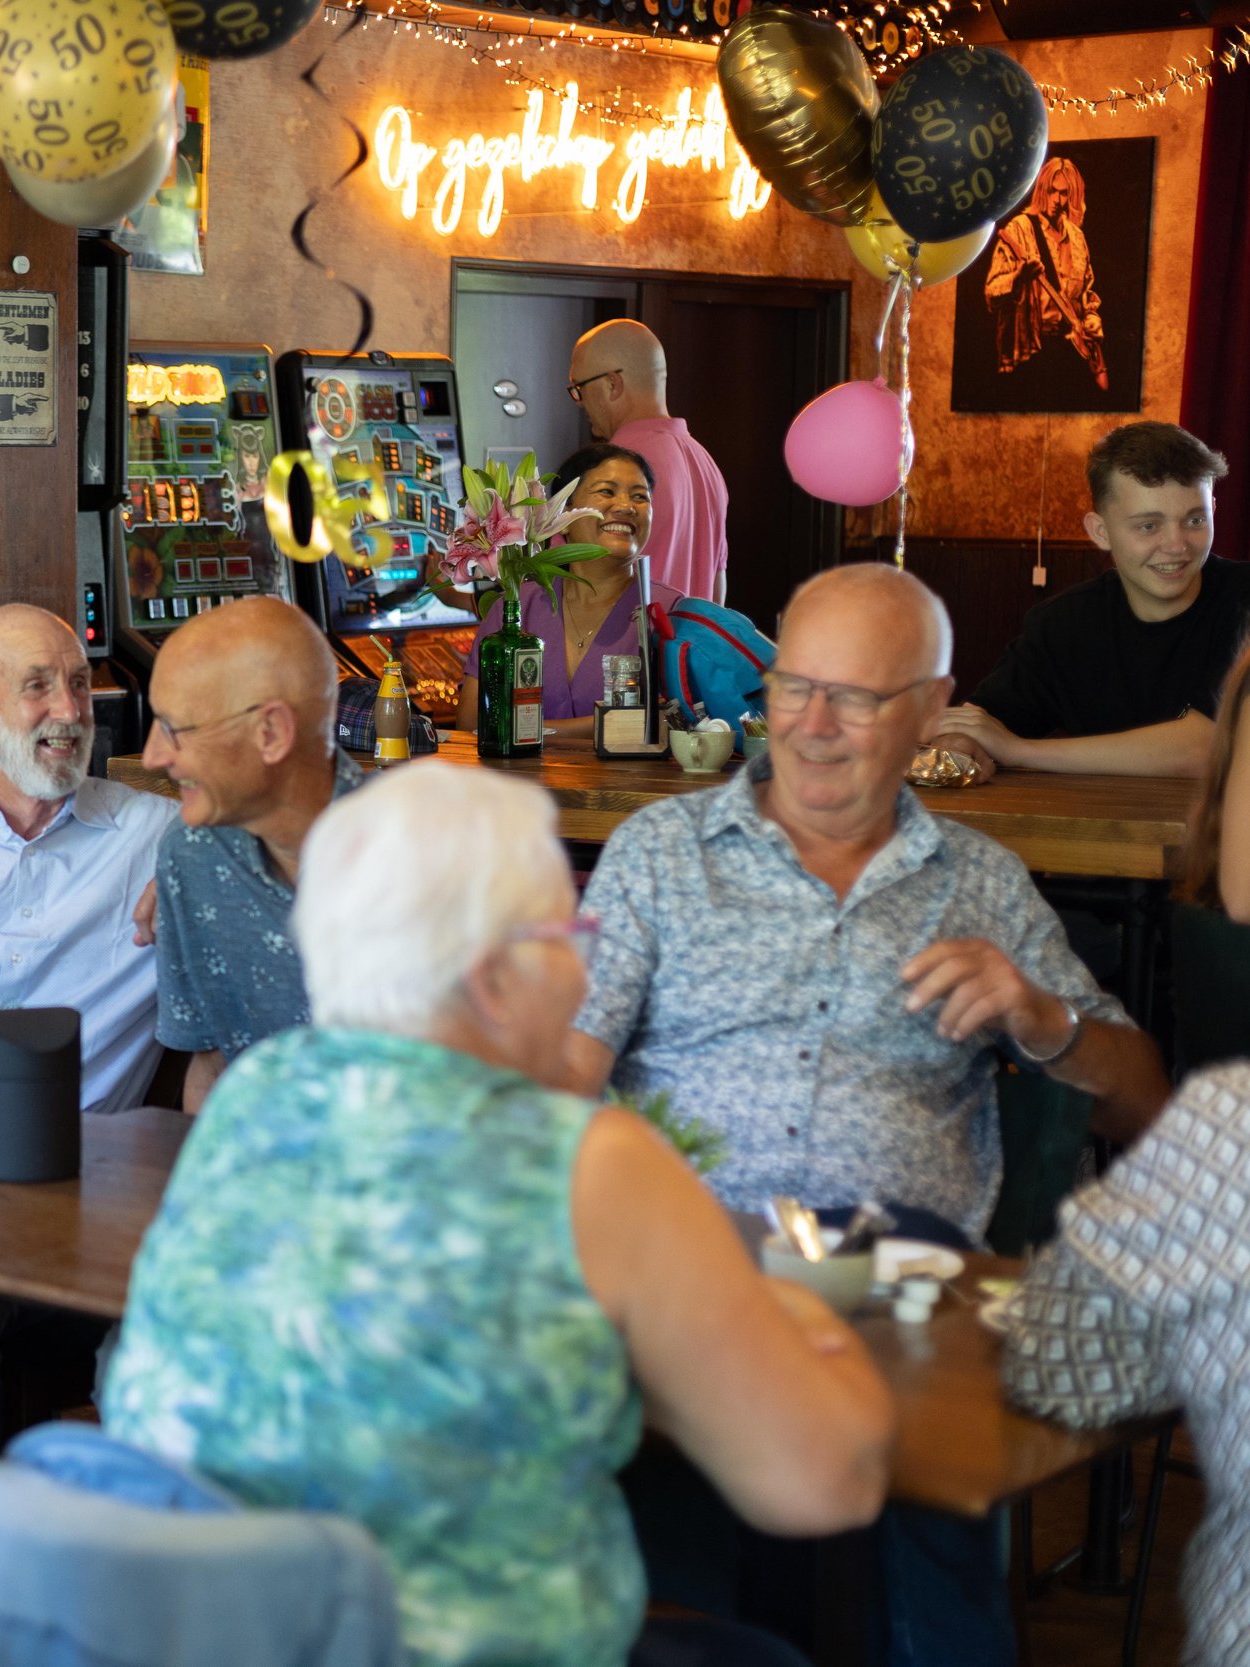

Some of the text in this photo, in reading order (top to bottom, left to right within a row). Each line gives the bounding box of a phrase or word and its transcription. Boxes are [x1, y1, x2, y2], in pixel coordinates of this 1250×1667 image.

[50, 13, 106, 71] 50
[215, 1, 270, 46] 50
[123, 38, 162, 95] 50
[947, 50, 988, 76] 50
[28, 98, 69, 146] 50
[84, 120, 128, 160] 50
[911, 98, 956, 142] 50
[969, 111, 1014, 160] 50
[376, 105, 437, 219] Op
[895, 155, 937, 196] 50
[950, 167, 995, 210] 50
[80, 363, 89, 377] 6
